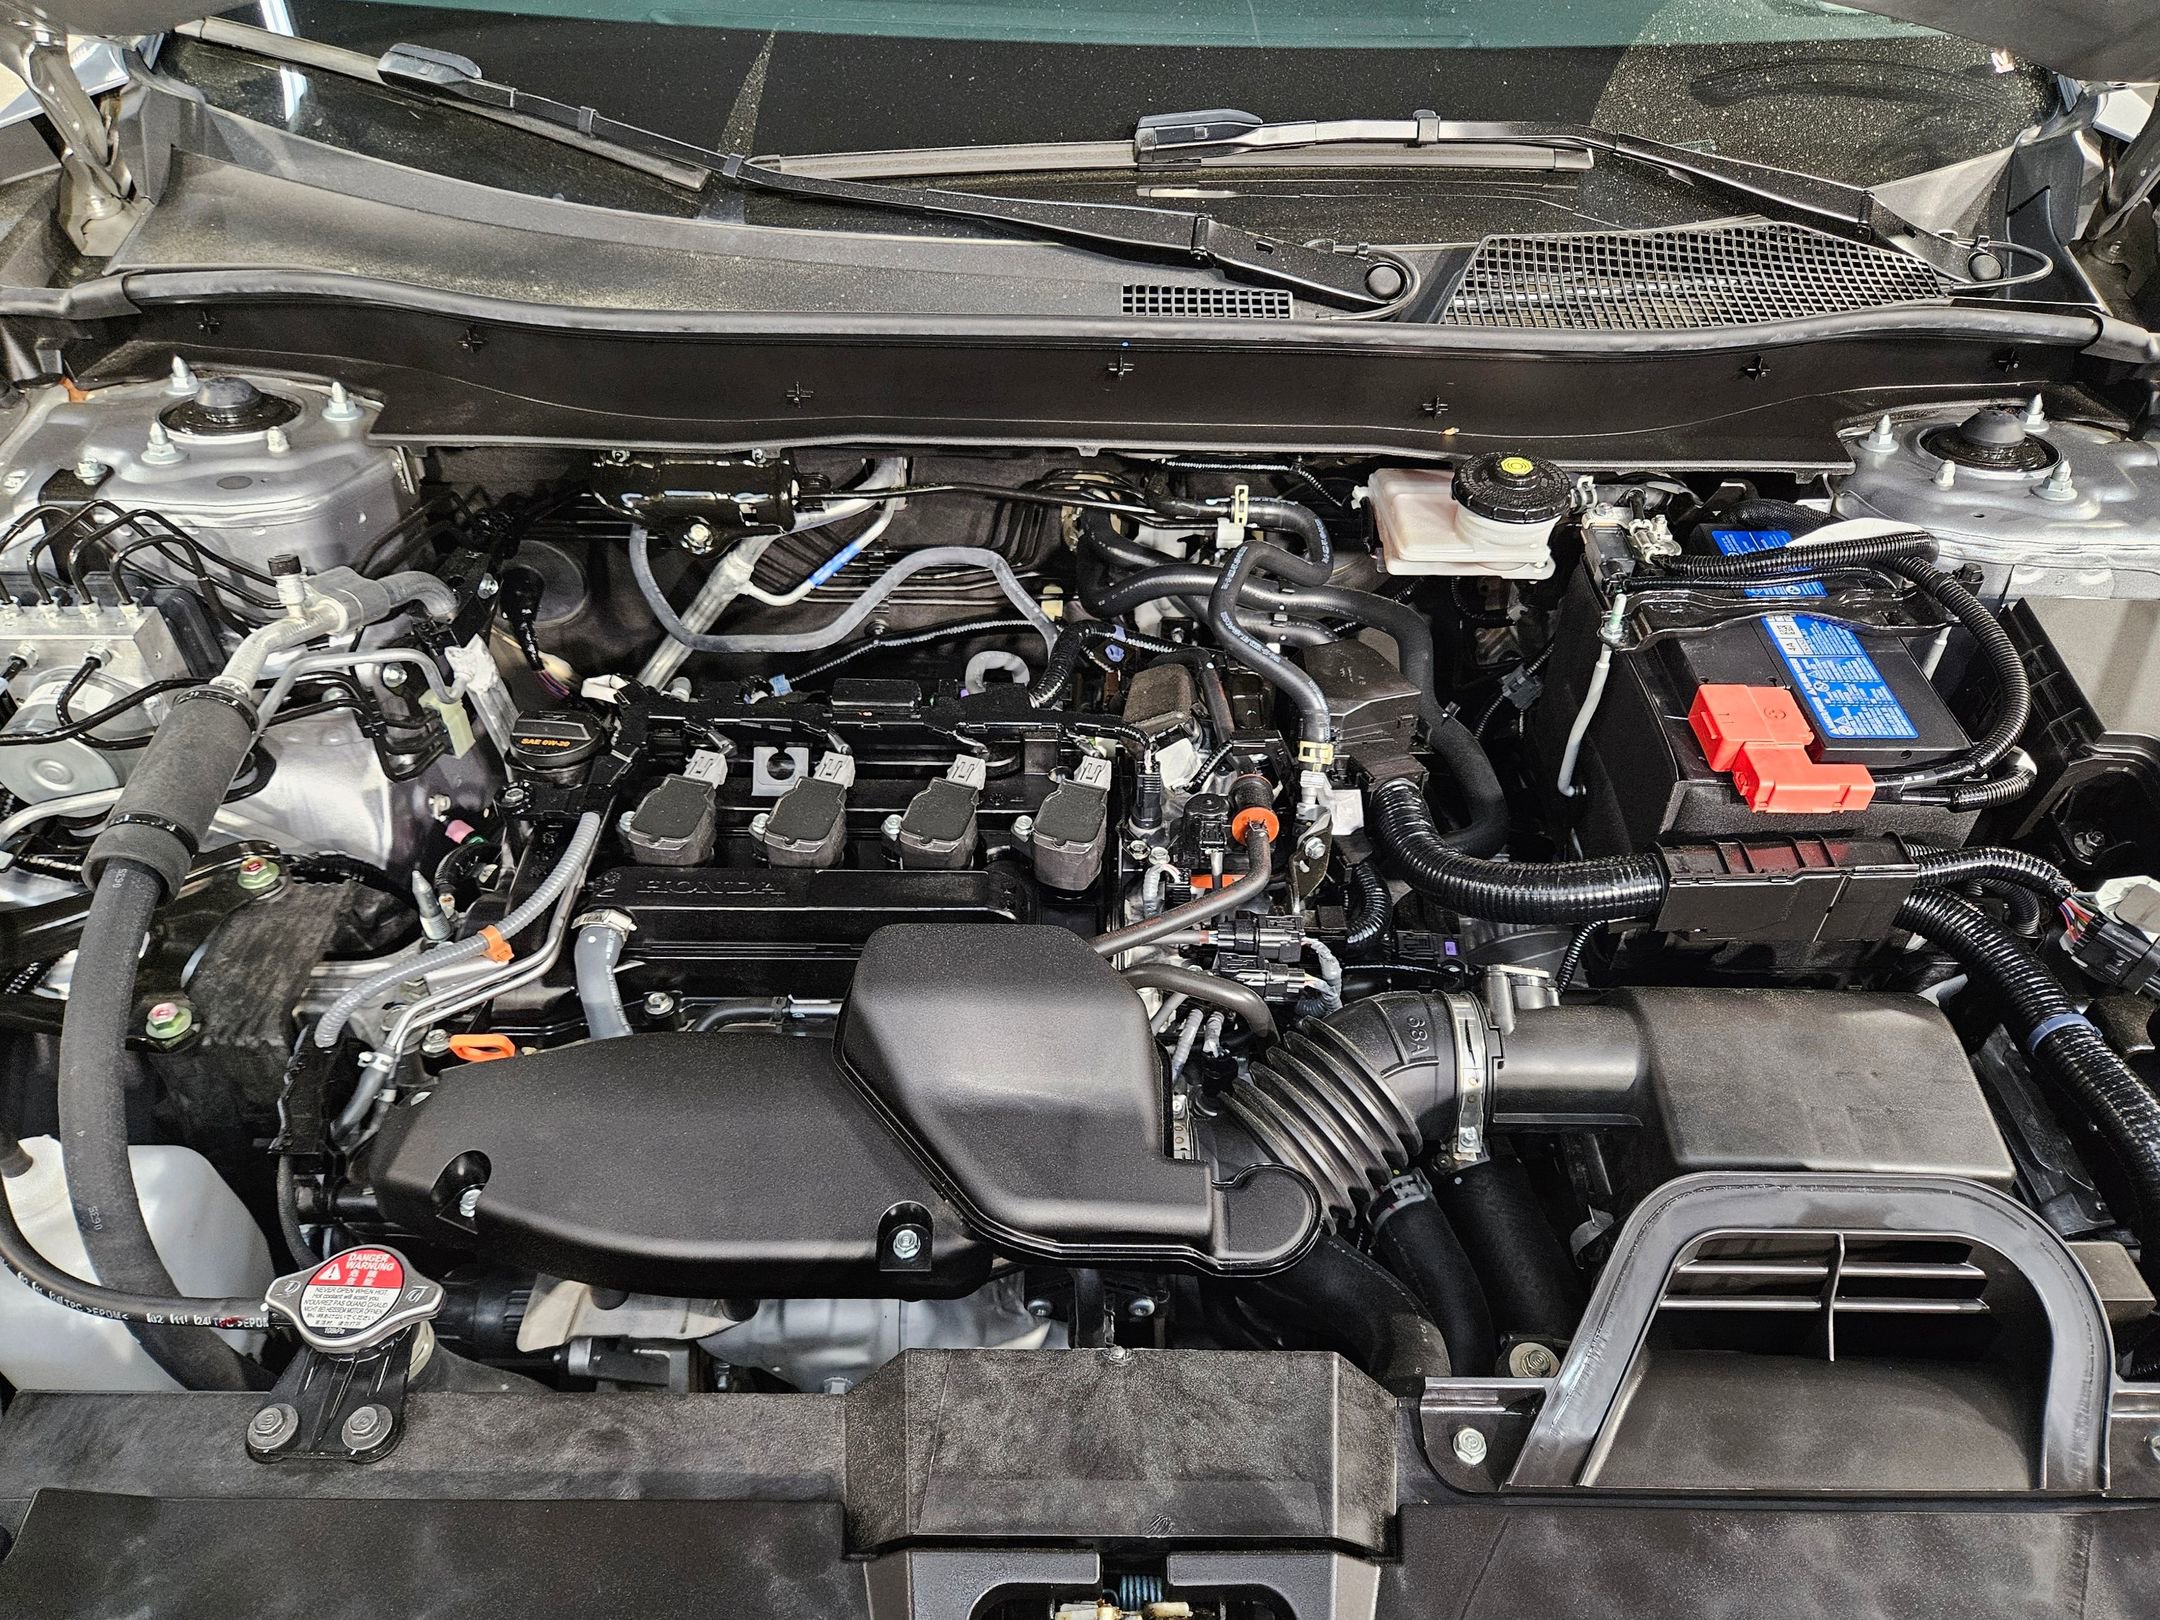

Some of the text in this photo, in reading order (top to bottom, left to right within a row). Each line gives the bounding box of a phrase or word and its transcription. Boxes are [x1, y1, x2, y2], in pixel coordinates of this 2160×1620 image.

[636, 880, 786, 895] HONDA
[350, 1253, 389, 1262] DANGER
[346, 1261, 395, 1271] WARNUNG
